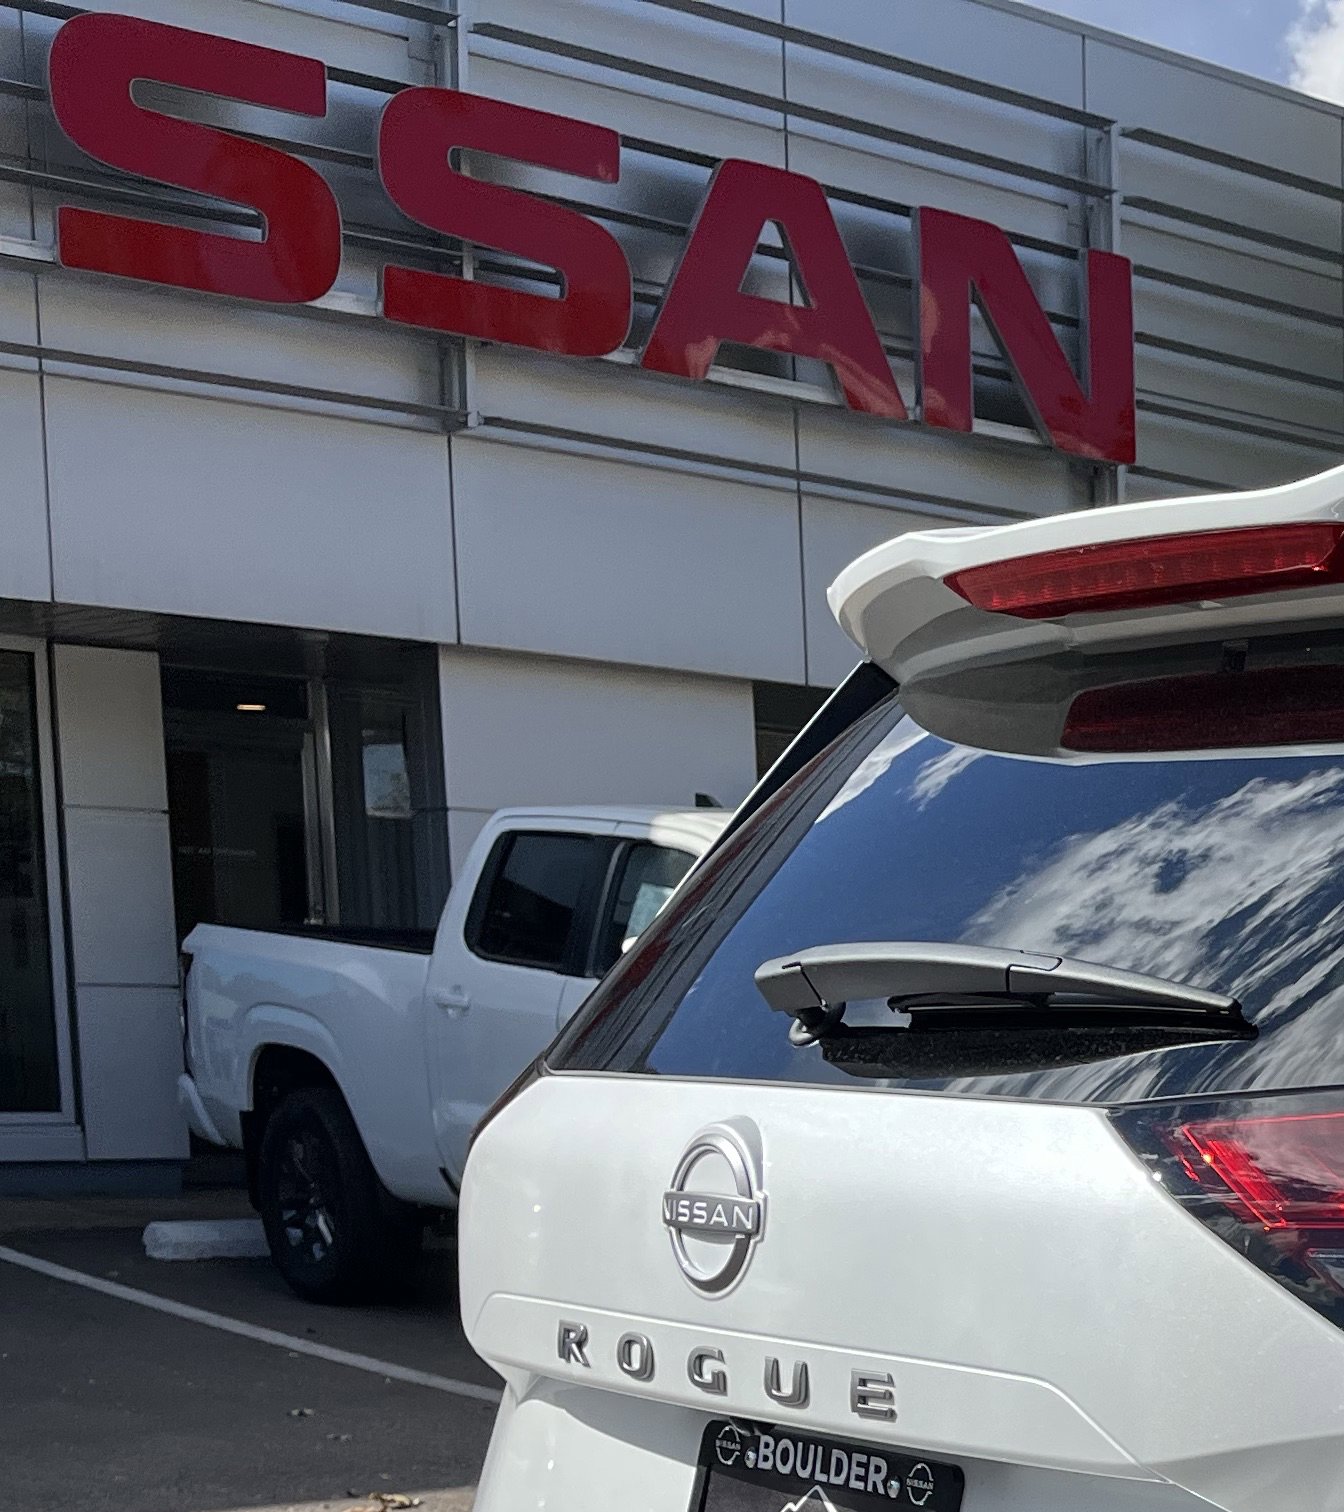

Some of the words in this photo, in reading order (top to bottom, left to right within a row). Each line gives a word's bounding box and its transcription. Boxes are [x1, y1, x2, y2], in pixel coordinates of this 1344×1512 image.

[48, 12, 1136, 464] SSAN
[663, 1198, 754, 1230] NISSAN
[557, 1319, 898, 1423] ROGUE
[756, 1434, 888, 1496] BOULDER
